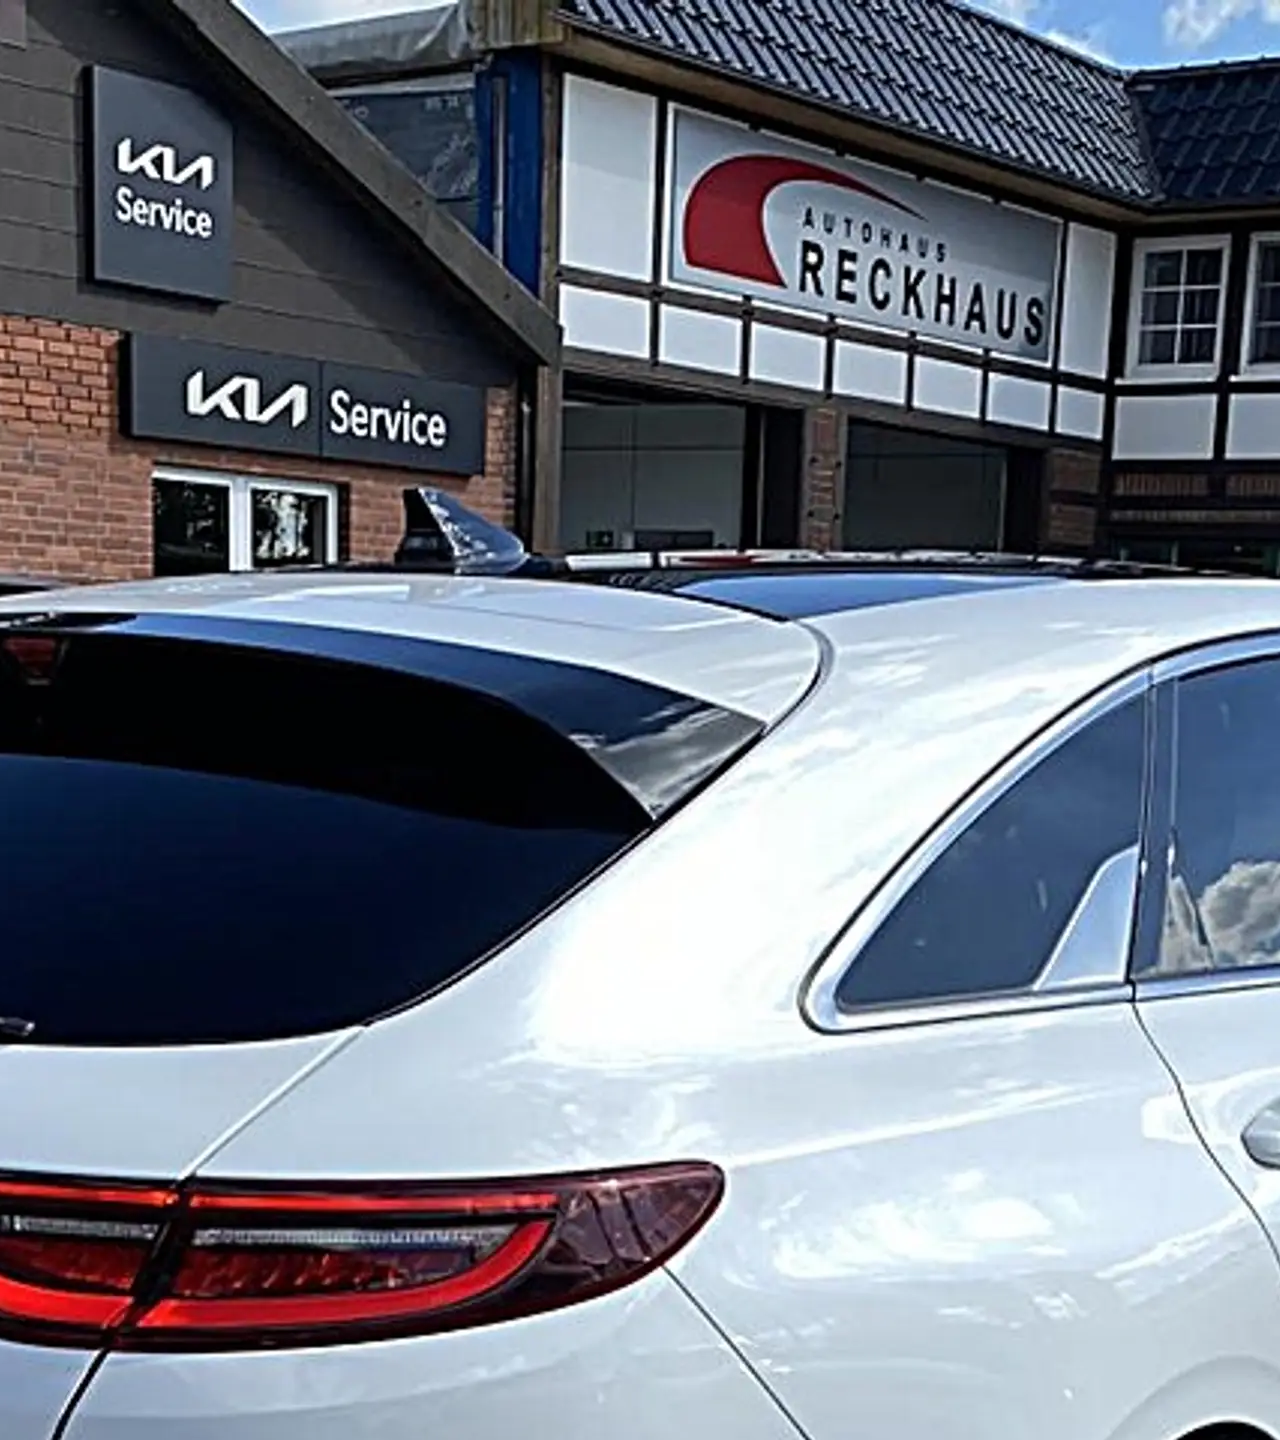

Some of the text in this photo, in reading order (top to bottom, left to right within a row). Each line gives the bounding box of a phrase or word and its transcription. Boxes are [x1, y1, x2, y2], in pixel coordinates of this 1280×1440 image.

[117, 186, 213, 239] Service
[802, 206, 946, 263] AUTOHAUS
[799, 239, 1045, 346] RECKHAUS
[329, 389, 447, 447] Service
